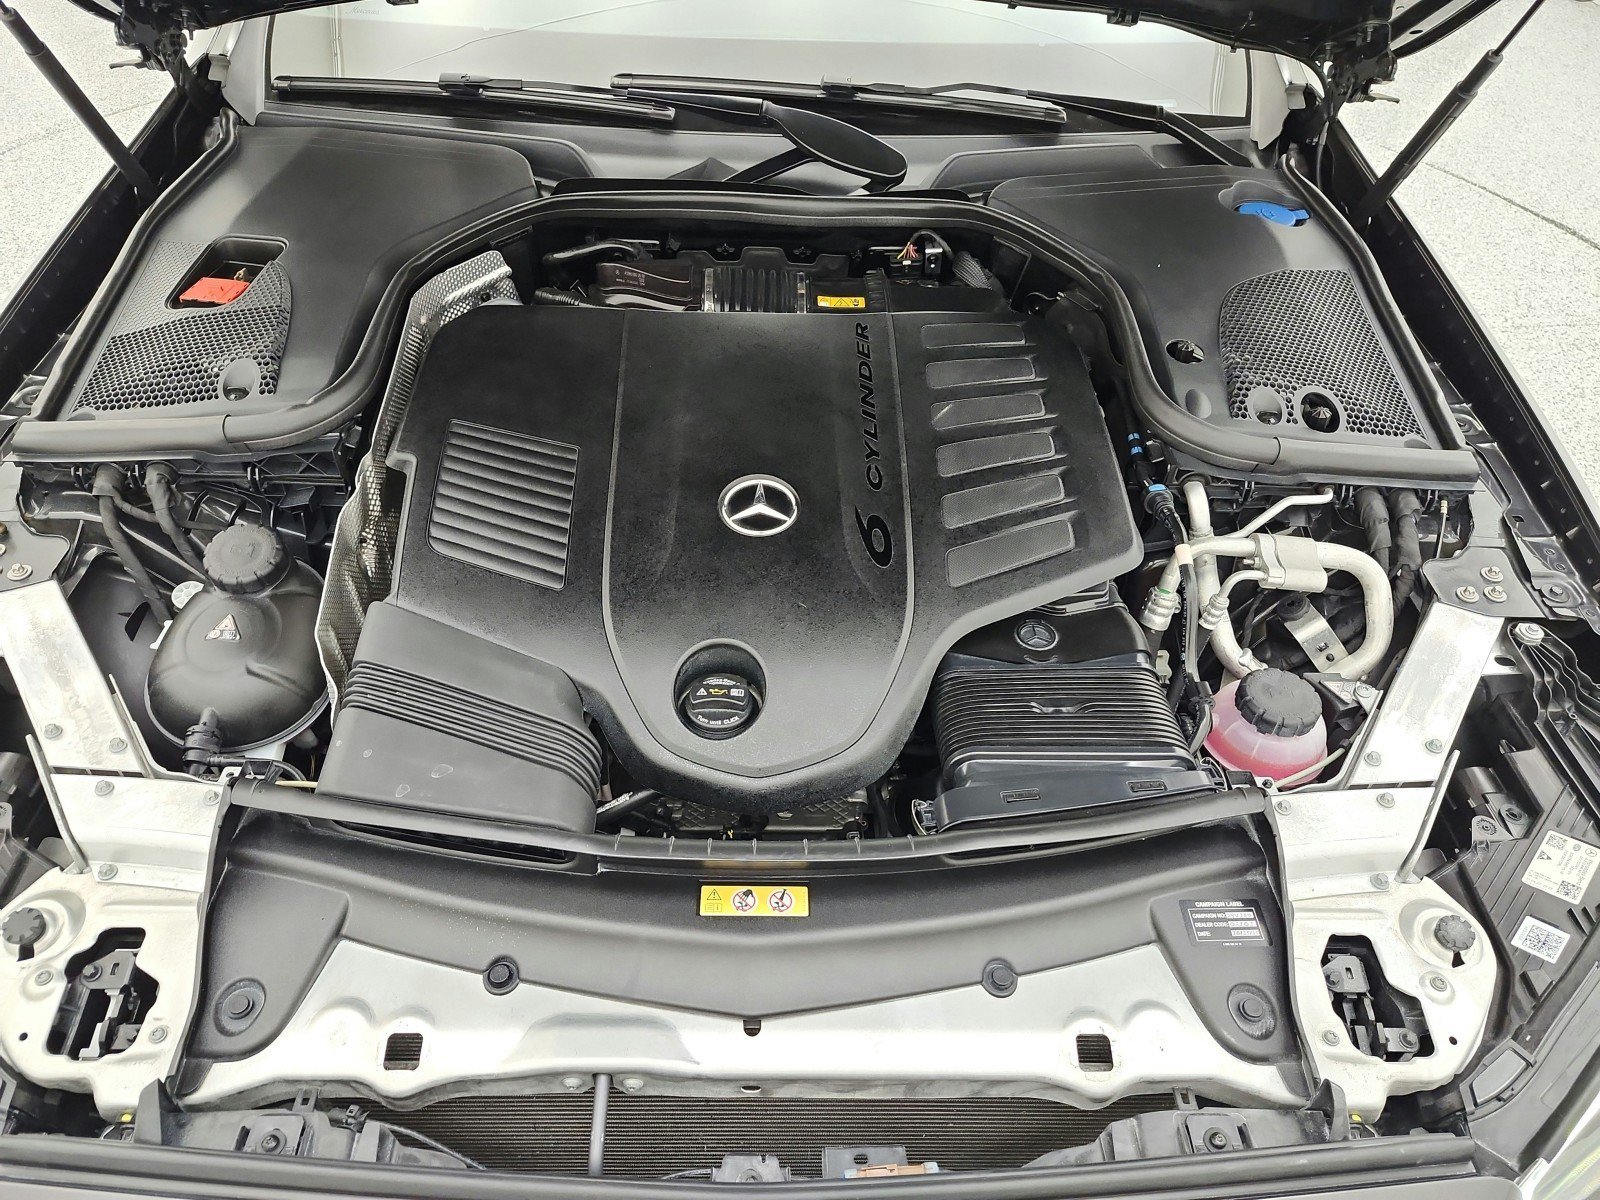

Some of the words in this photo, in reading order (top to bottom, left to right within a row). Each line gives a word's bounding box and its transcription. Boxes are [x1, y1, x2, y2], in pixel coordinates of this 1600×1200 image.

[855, 322, 883, 492] CYLINDER
[854, 505, 893, 569] 6
[697, 714, 709, 724] Turn
[723, 715, 740, 725] CLICK
